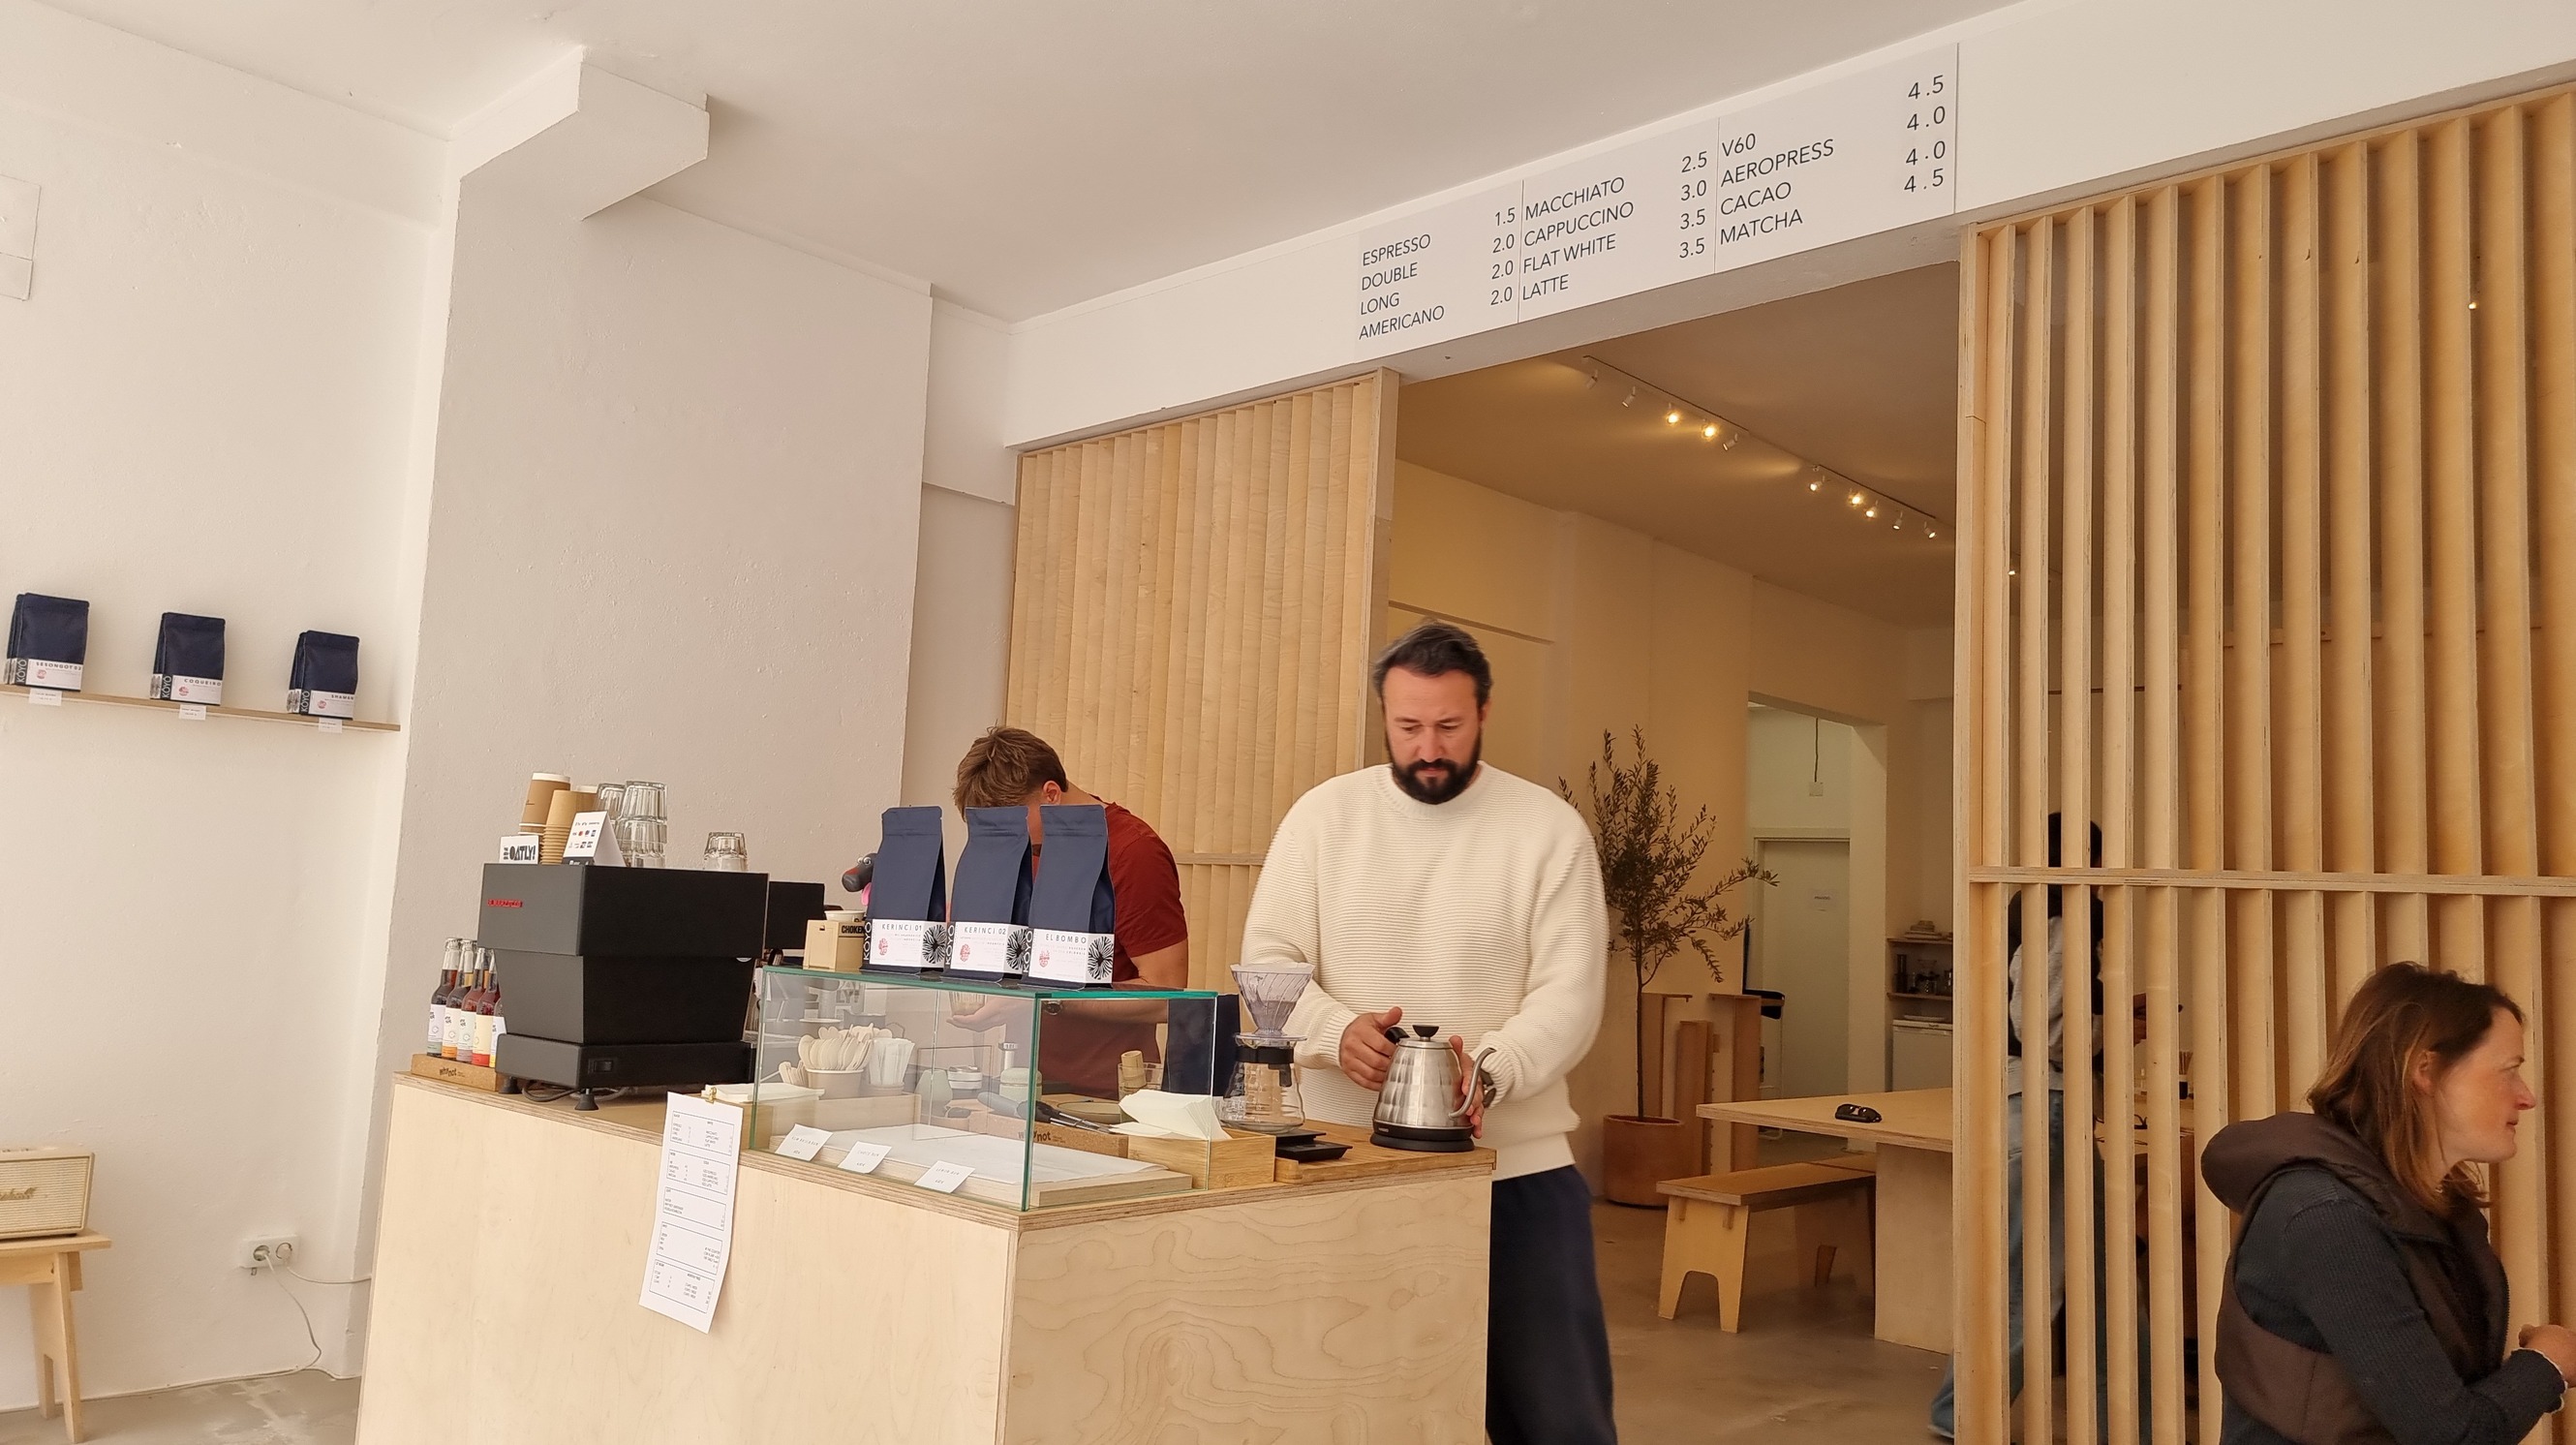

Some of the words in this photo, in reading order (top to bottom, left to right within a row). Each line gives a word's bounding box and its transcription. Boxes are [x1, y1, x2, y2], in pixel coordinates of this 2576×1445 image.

[1720, 138, 1834, 188] AEROPRESS
[1906, 105, 1947, 132] 4.0
[1721, 133, 1757, 157] V60
[1907, 74, 1944, 100] 4.5
[1525, 176, 1625, 221] MACCHIATO
[1681, 150, 1707, 173] 2.5
[1720, 181, 1792, 216] CACAO
[1905, 139, 1947, 167] 4.0
[1720, 208, 1803, 246] MATCHA
[1903, 168, 1944, 193] 4.5
[1363, 233, 1431, 267] ESPRESSO
[1494, 206, 1516, 227] 1.5
[1523, 200, 1635, 247] CAPPUCCINO
[1680, 179, 1707, 201] 3.0
[1523, 249, 1561, 274] FLAT
[1563, 232, 1616, 262] WHITE
[1679, 207, 1706, 231] 3.5
[1360, 292, 1400, 316] LONG
[1491, 260, 1514, 280] 2.0
[1362, 261, 1419, 292] DOUBLE
[1492, 233, 1515, 254] 2.0
[1522, 273, 1570, 301] LATTE
[1678, 236, 1705, 259] 3.5
[1359, 305, 1445, 341] AMERICANO
[1489, 286, 1513, 306] 2.0
[964, 926, 996, 935] KERINCI
[1056, 935, 1087, 944] BOMBO
